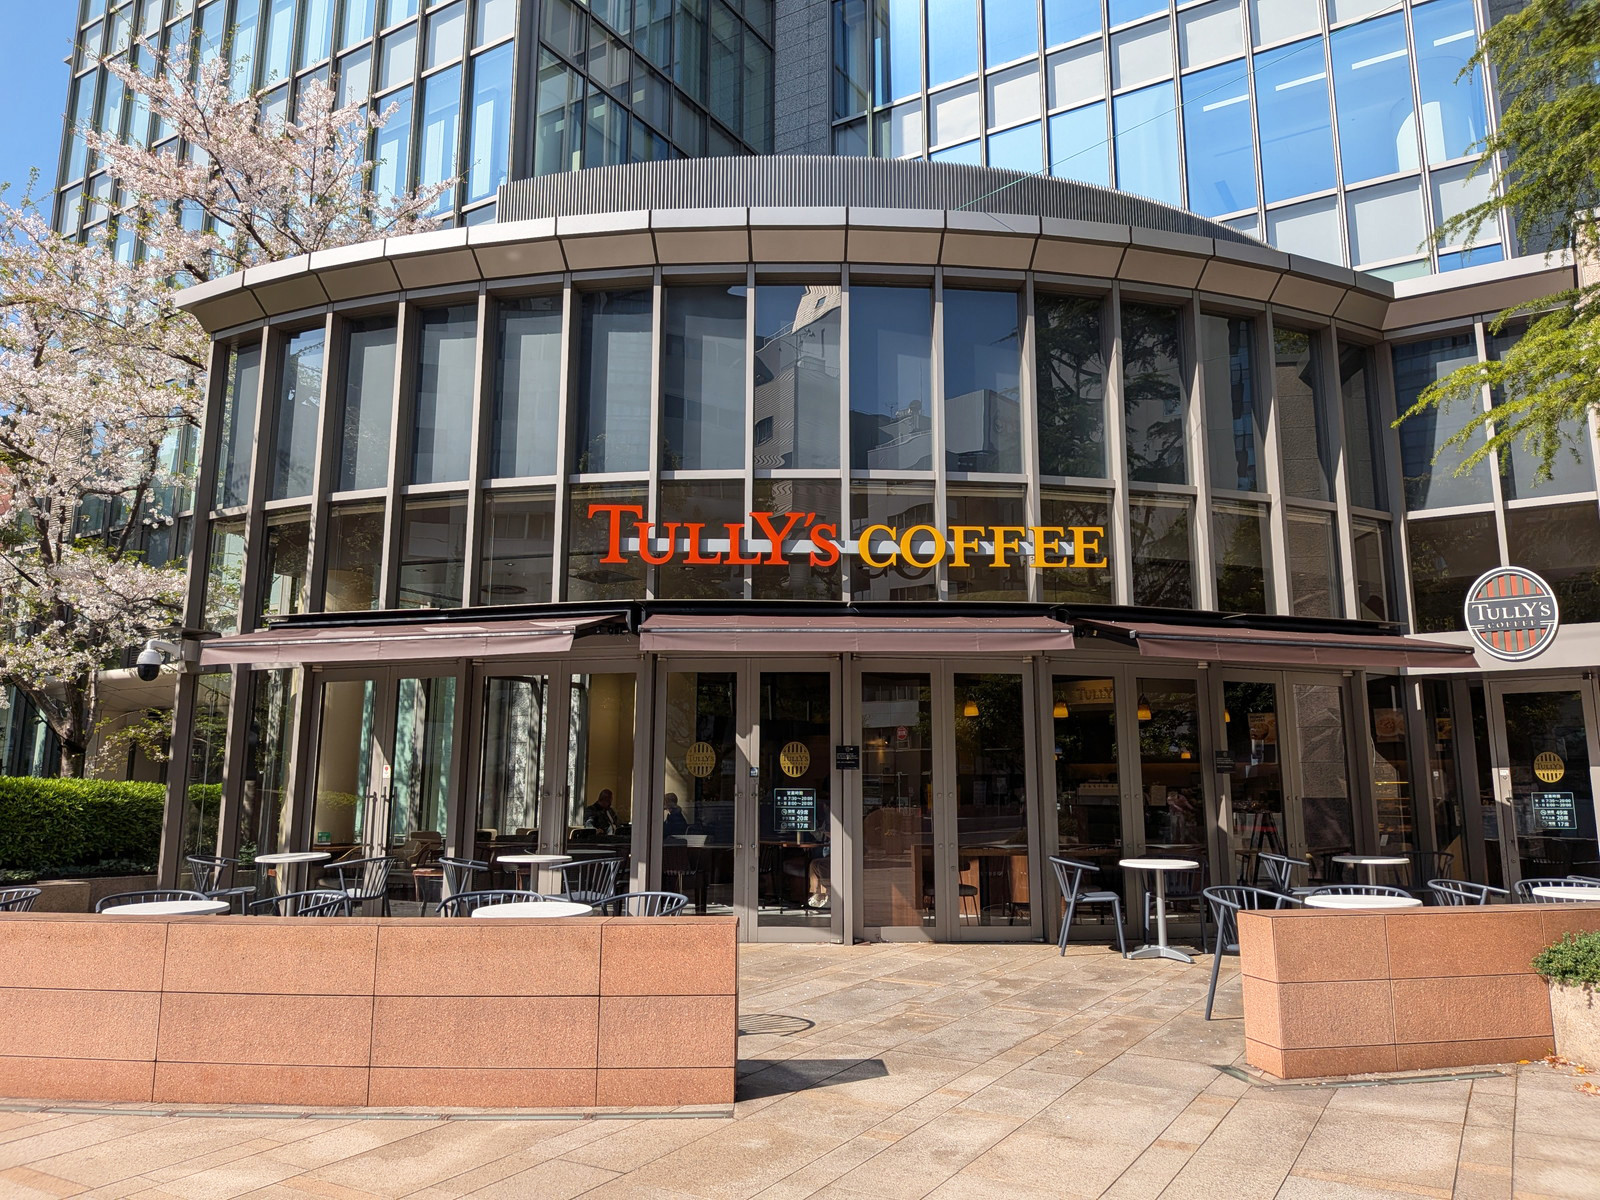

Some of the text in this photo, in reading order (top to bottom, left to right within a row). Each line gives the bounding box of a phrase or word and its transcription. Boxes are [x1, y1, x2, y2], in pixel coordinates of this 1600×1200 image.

[588, 504, 1107, 569] TULLY'S COFFEE
[1471, 601, 1551, 621] TULLY'S
[1487, 619, 1537, 629] COFFEE
